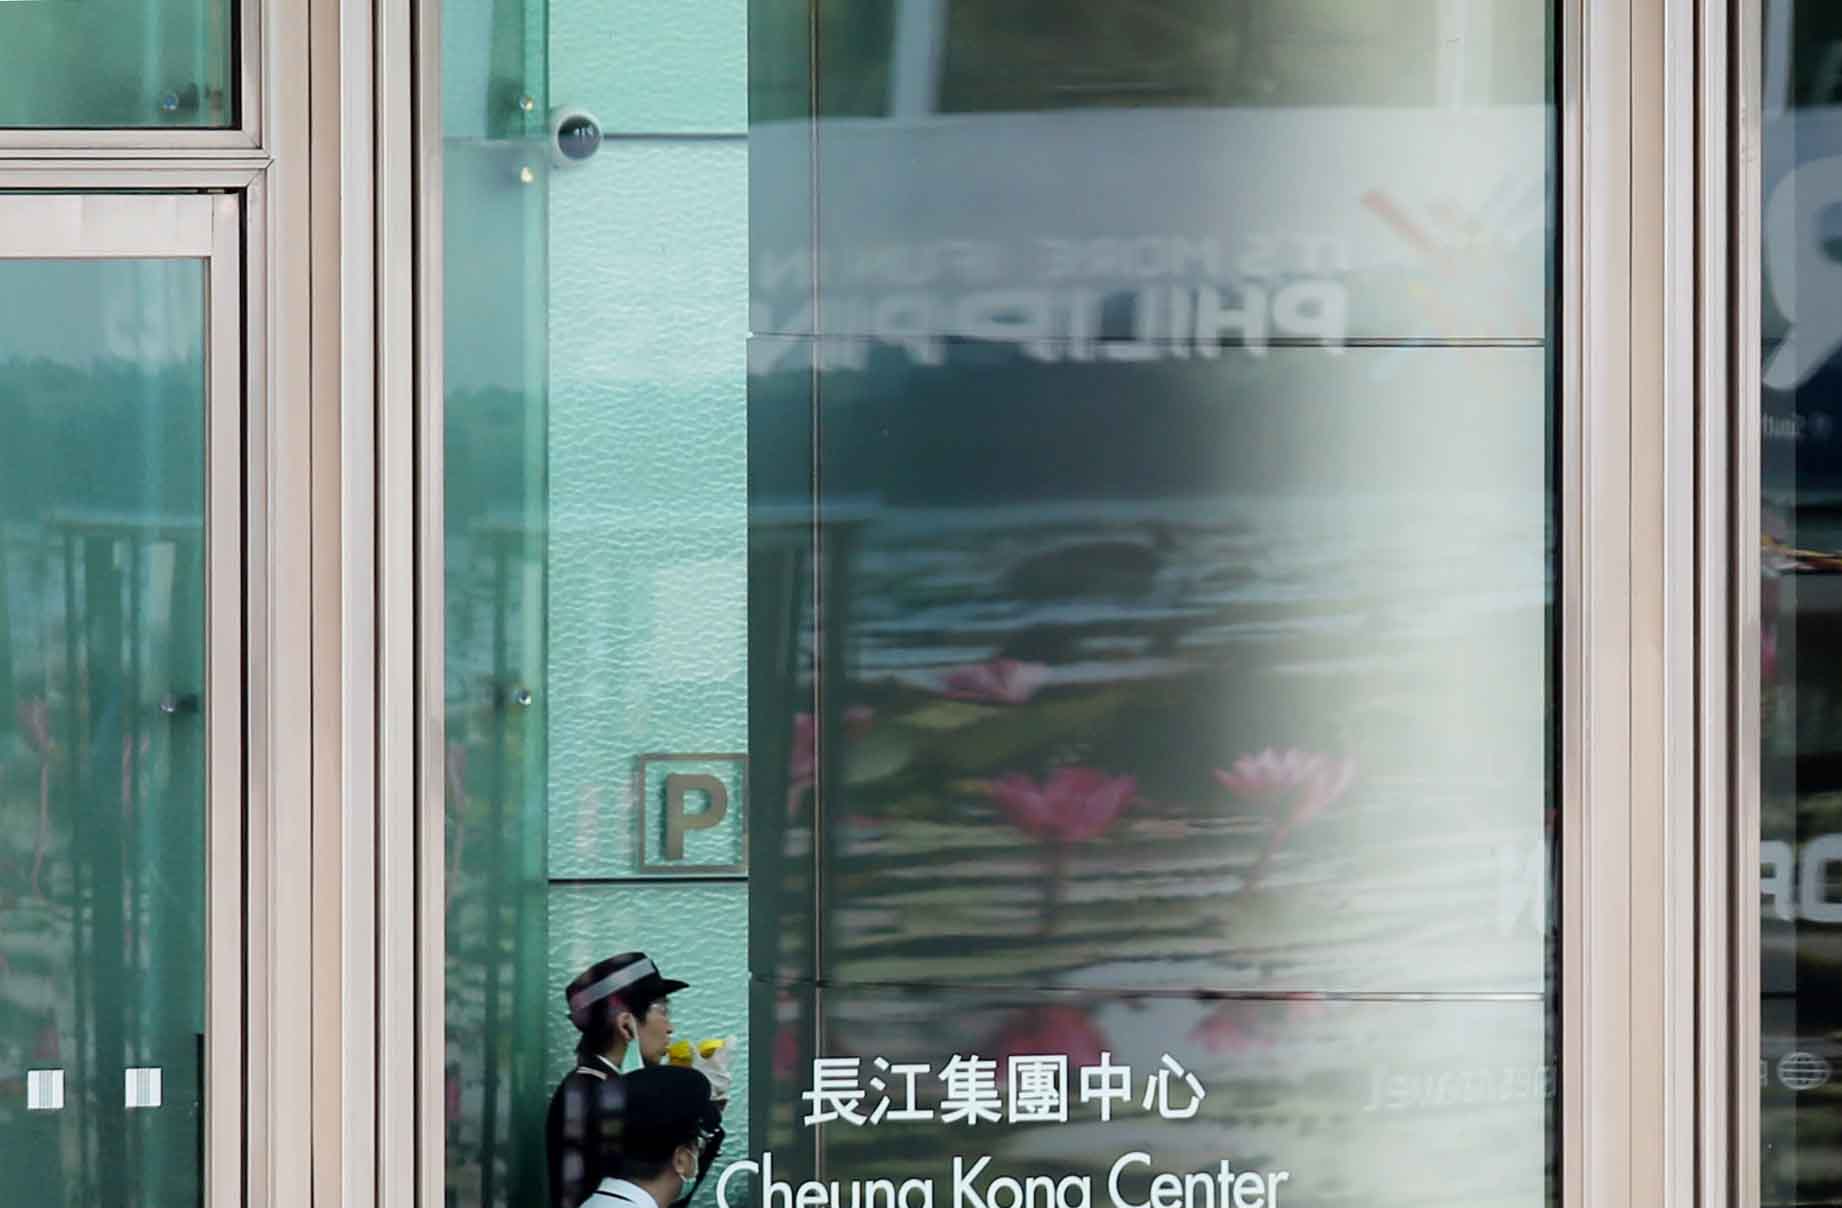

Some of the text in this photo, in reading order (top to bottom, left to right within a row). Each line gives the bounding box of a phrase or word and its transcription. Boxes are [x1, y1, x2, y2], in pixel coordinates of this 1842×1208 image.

[664, 771, 729, 862] P
[800, 1050, 1207, 1128] 長江集團中心
